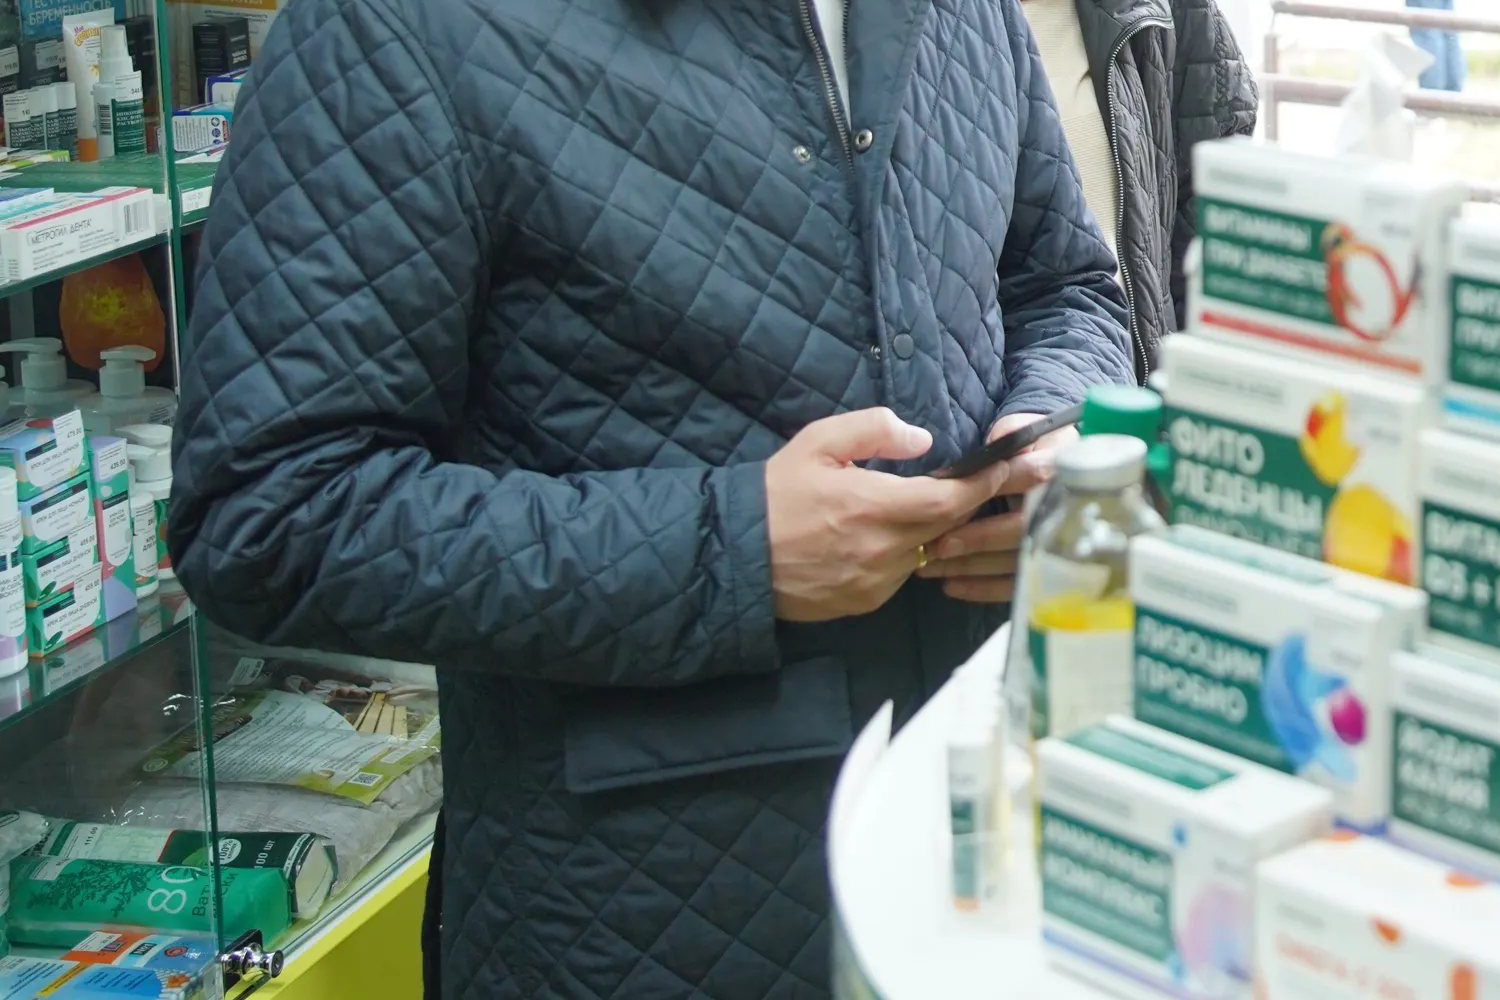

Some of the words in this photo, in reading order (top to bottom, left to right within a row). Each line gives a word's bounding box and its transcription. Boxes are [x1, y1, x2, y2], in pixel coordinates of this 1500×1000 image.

[1170, 415, 1265, 475] ФИТО
[1173, 458, 1323, 534] ЛЕДЕНЦЫ
[1138, 615, 1263, 684] ЛИЗОЦИМ
[1137, 653, 1248, 725] ПРОБИО
[263, 840, 276, 851] шт
